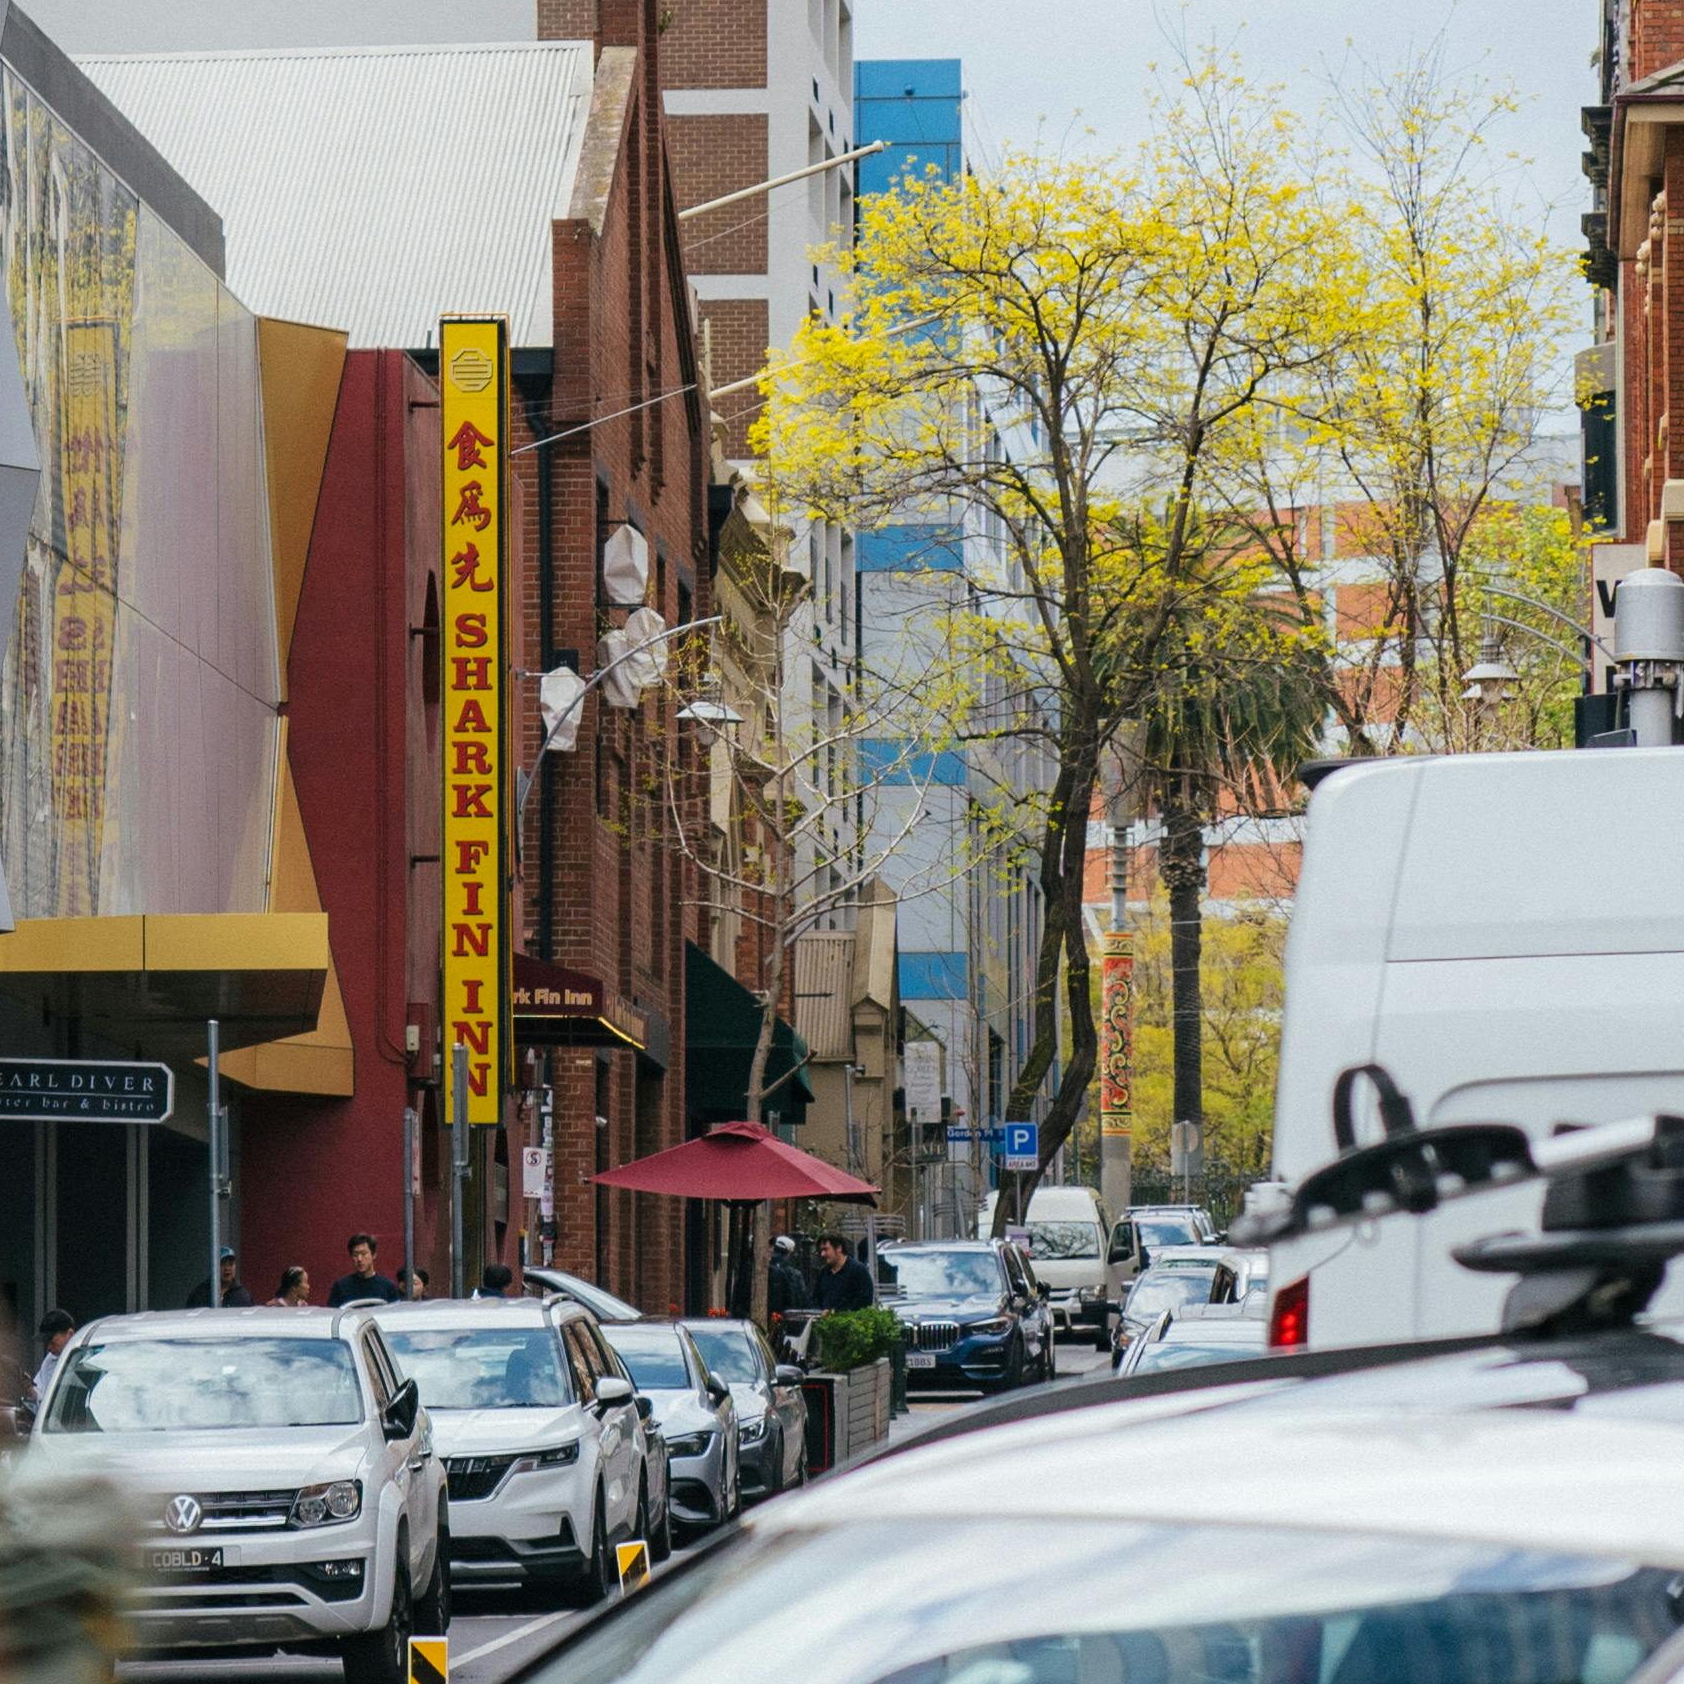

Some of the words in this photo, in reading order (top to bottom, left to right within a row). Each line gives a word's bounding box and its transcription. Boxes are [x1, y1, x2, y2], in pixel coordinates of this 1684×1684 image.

[451, 613, 494, 818] SHARK
[451, 840, 493, 957] FIN
[534, 988, 560, 1005] Fin
[565, 989, 593, 1006] Inn
[71, 1074, 154, 1092] DIVER
[42, 1096, 69, 1108] bar
[80, 1098, 90, 1109] &
[102, 1099, 154, 1112] bistro
[1013, 1129, 1030, 1150] P
